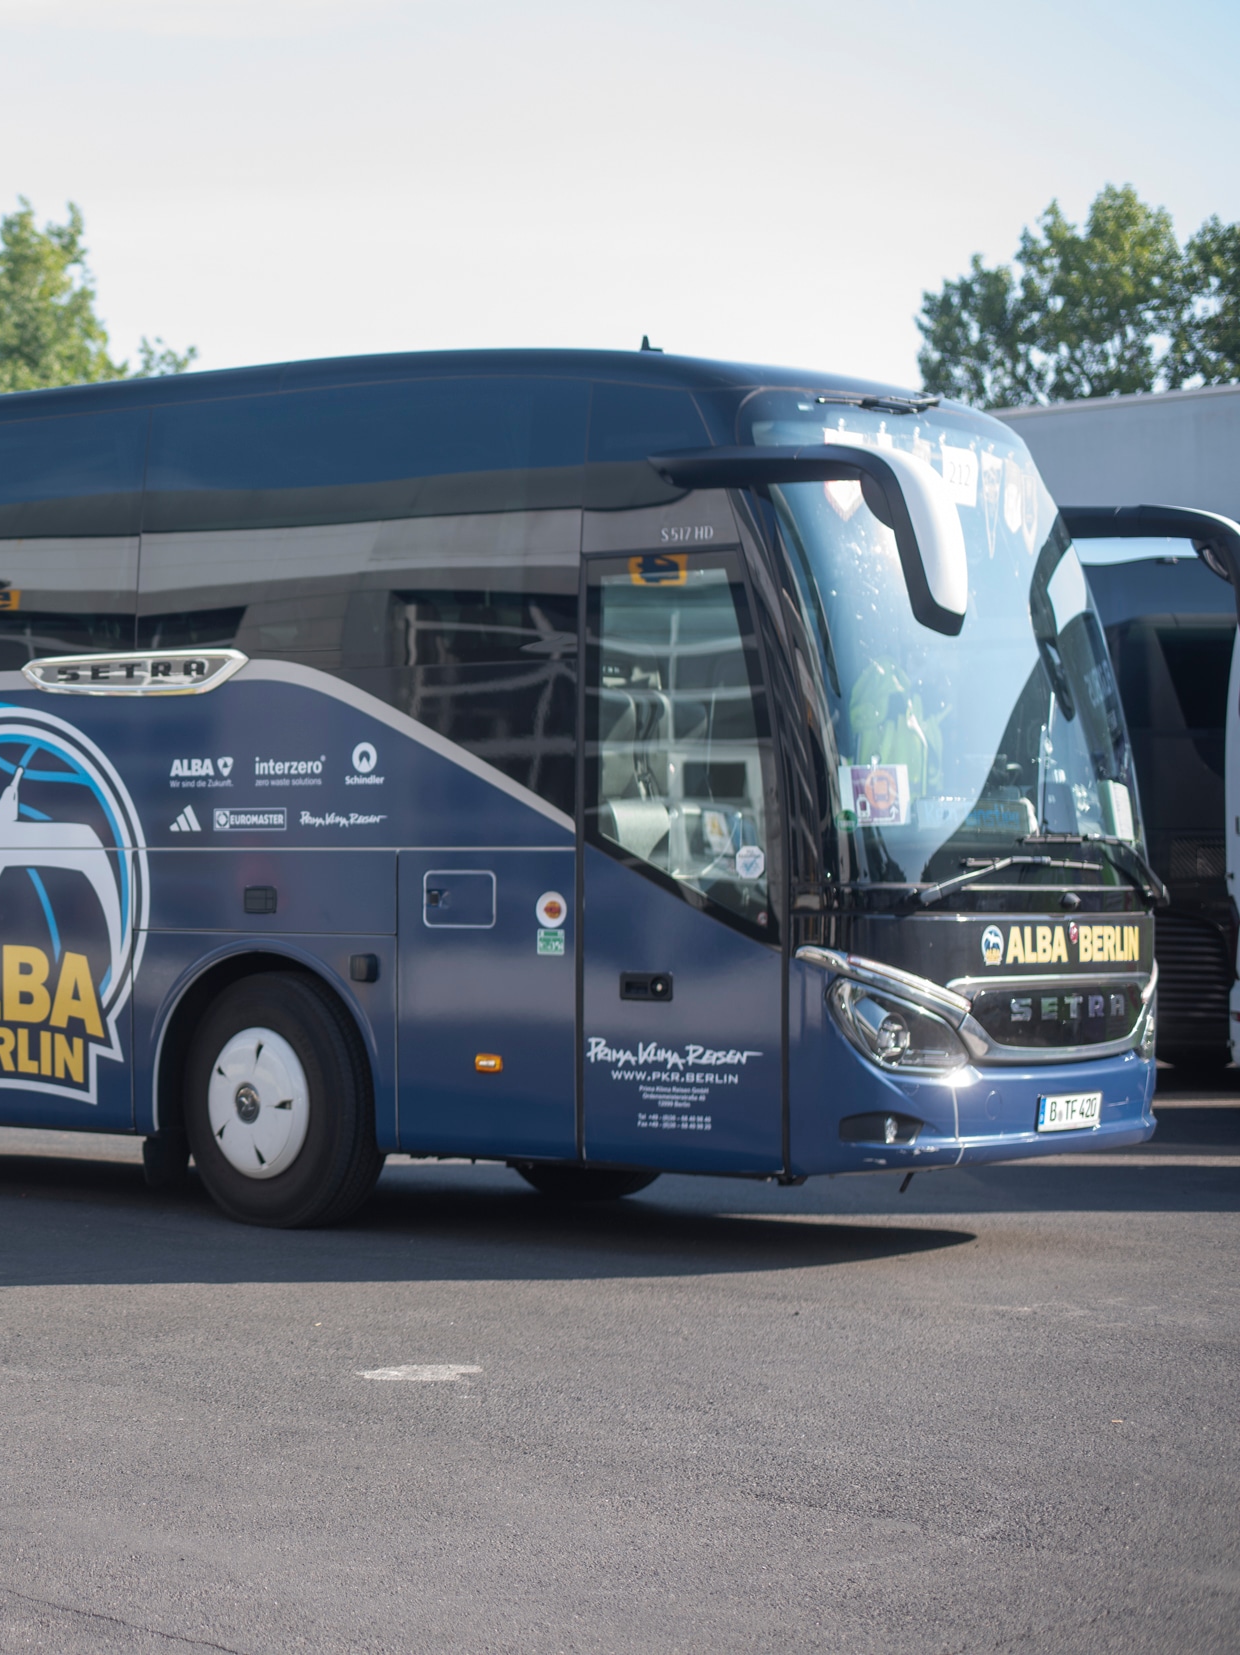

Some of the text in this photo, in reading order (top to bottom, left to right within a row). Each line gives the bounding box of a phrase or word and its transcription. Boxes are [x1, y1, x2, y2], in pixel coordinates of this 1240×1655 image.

[949, 461, 971, 486] 212
[661, 525, 714, 542] S 517 HD
[57, 659, 205, 682] SETRA
[169, 758, 215, 777] ALBA
[169, 779, 181, 788] Wir
[181, 779, 196, 788] sind
[196, 779, 207, 787] die
[255, 779, 270, 787] zero
[291, 777, 322, 786] solutions
[345, 775, 385, 786] Schindler
[230, 813, 284, 825] EUROMASTER
[1005, 925, 1139, 964] ALBA BERLIN
[1010, 994, 1126, 1022] SETRA
[611, 1069, 739, 1084] WWW.PKR.BERLIN
